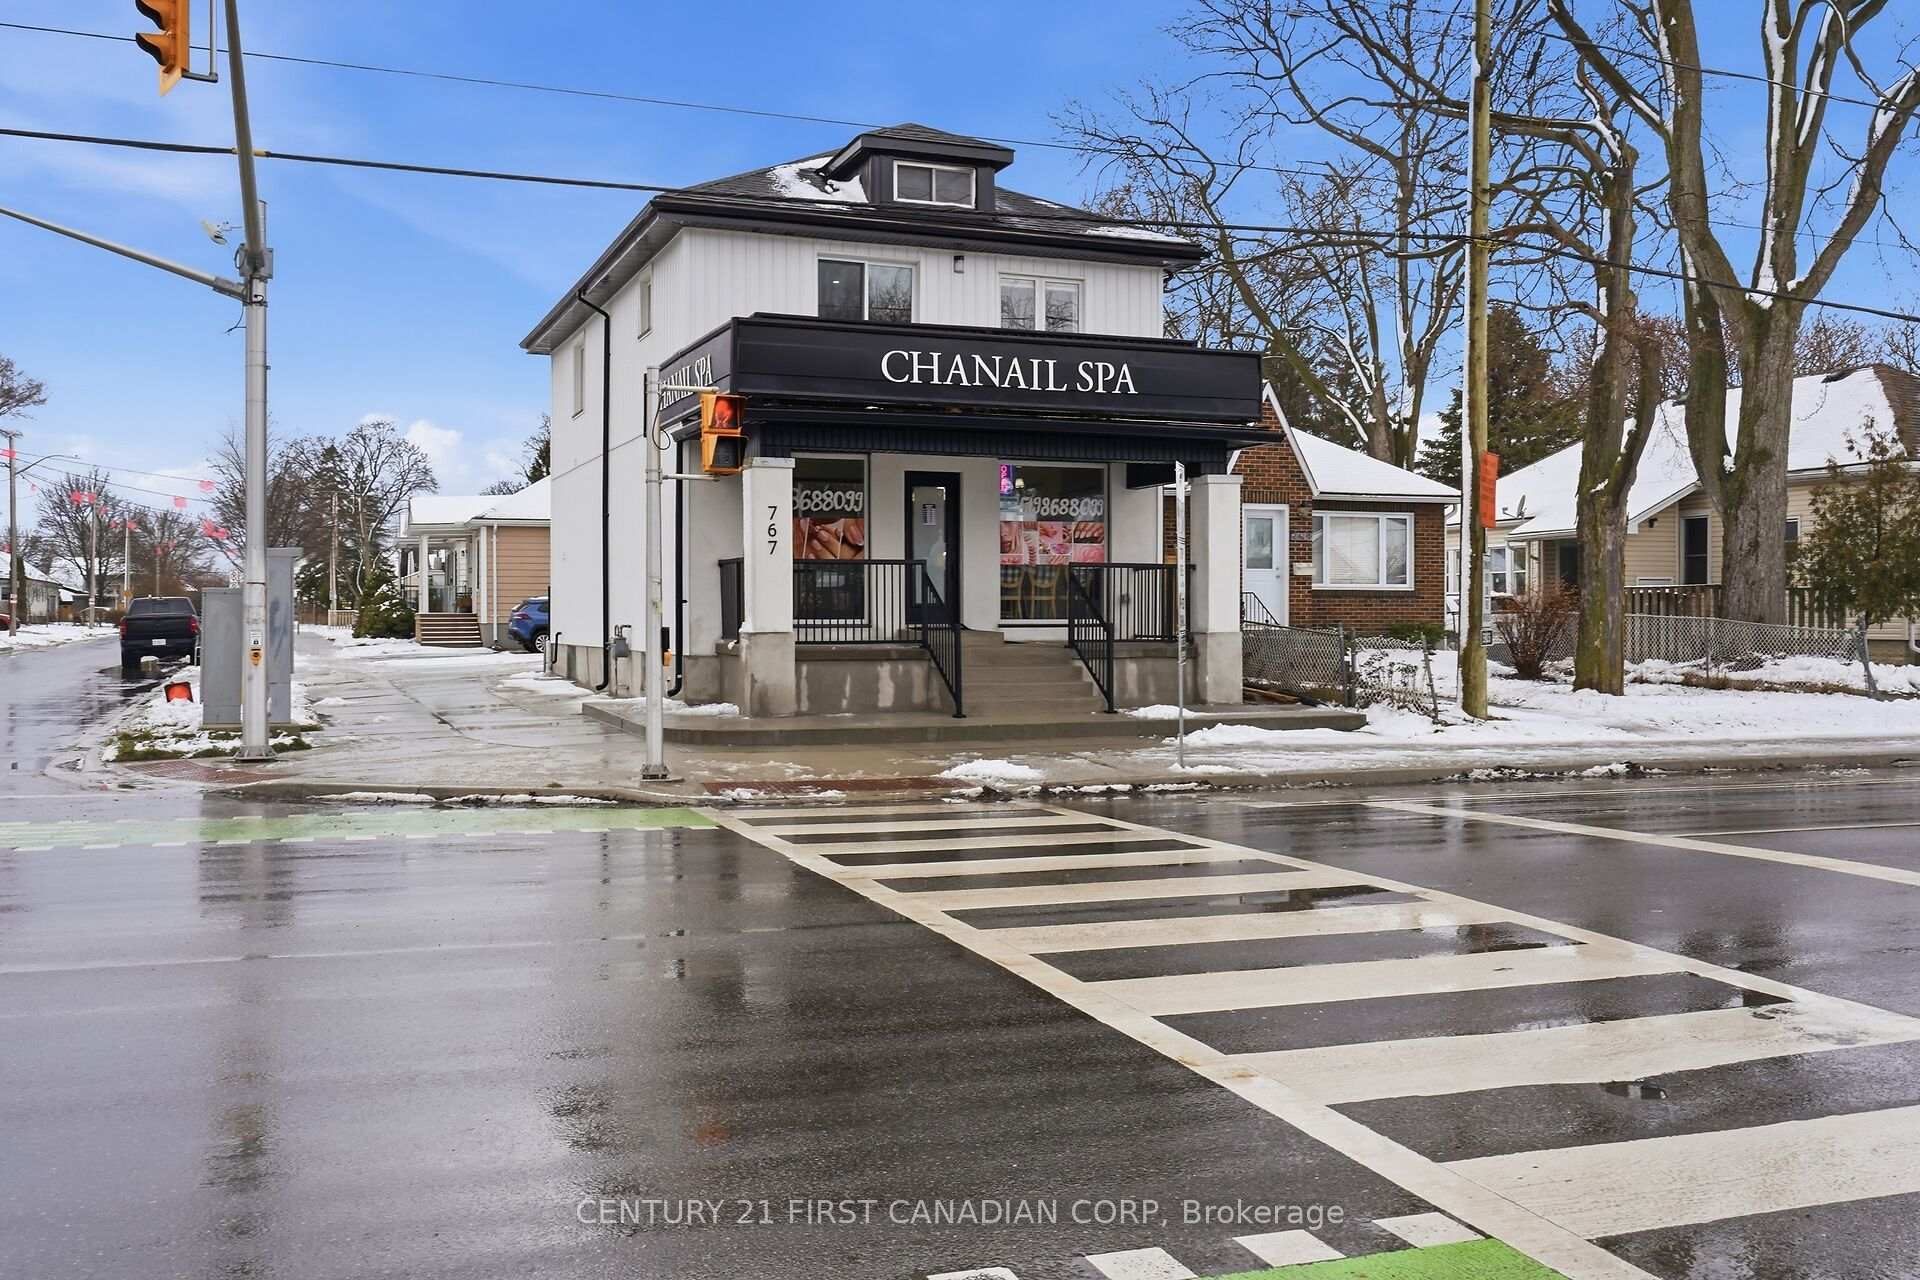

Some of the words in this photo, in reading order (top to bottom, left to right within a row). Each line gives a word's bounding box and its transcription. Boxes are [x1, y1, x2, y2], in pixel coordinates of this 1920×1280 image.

[659, 365, 693, 411] HANAIL
[694, 353, 713, 388] SPA
[881, 350, 1068, 392] CHANAIL
[1076, 361, 1139, 394] SPA
[767, 505, 778, 555] 767
